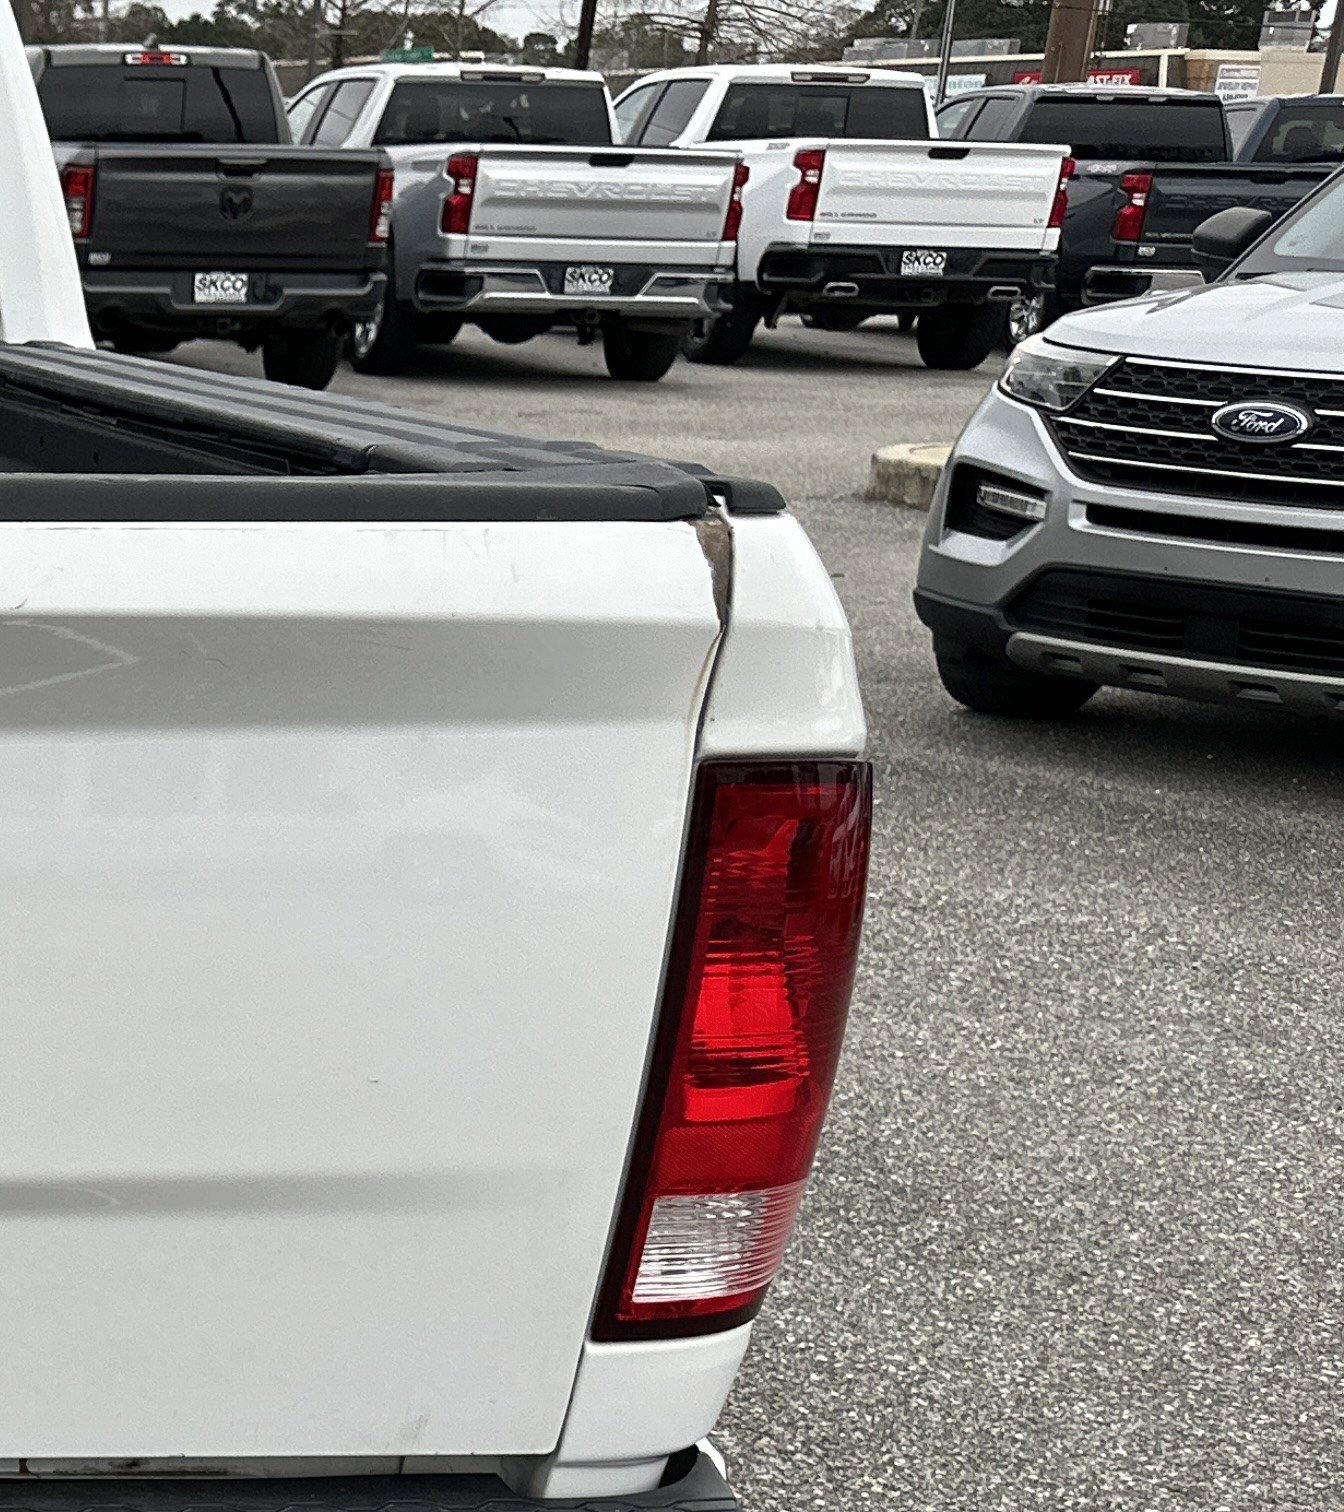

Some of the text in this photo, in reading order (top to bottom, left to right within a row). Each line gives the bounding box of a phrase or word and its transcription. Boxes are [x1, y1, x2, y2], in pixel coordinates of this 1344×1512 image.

[903, 252, 944, 266] SKCO
[195, 276, 247, 291] SKCO
[1231, 410, 1285, 433] Ford
